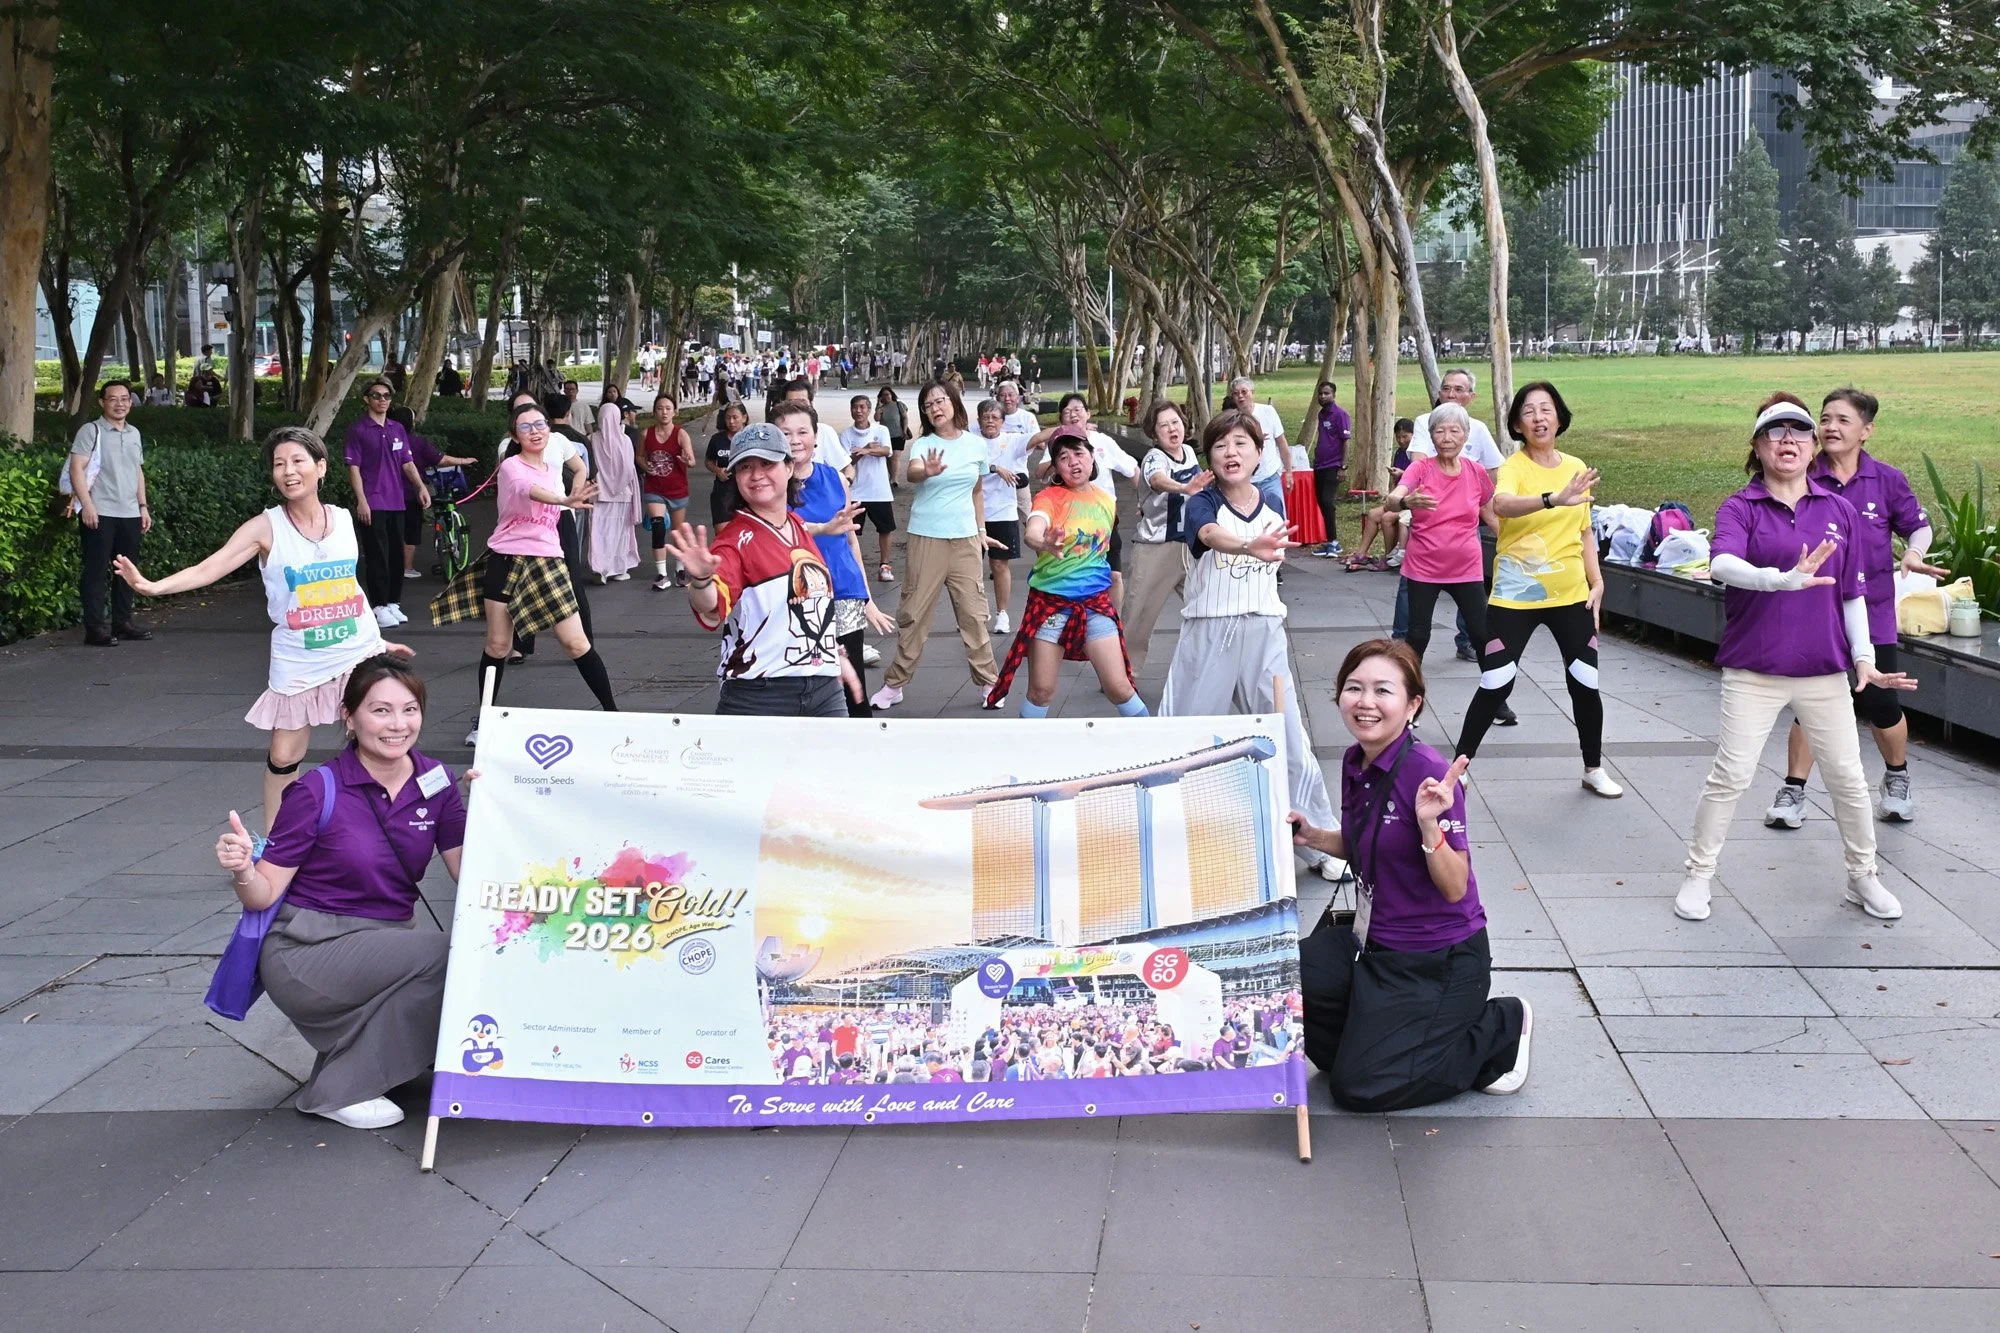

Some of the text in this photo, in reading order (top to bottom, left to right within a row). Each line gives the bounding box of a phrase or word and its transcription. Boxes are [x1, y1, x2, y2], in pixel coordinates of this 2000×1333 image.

[303, 564, 354, 581] WORK
[300, 603, 358, 622] DREAM
[314, 625, 350, 641] BIG
[514, 775, 575, 784] Blossom Seeds
[480, 880, 748, 923] READY SET Gold!
[565, 922, 655, 952] 2026
[682, 948, 712, 966] CHOPE
[1153, 954, 1178, 968] SG
[1151, 968, 1176, 983] 60
[523, 1022, 597, 1034] Sector Administrator
[696, 1028, 737, 1037] Operator of
[688, 1056, 702, 1064] SG
[704, 1056, 730, 1064] Cares
[728, 1091, 1015, 1115] To Serve with Love and Care
